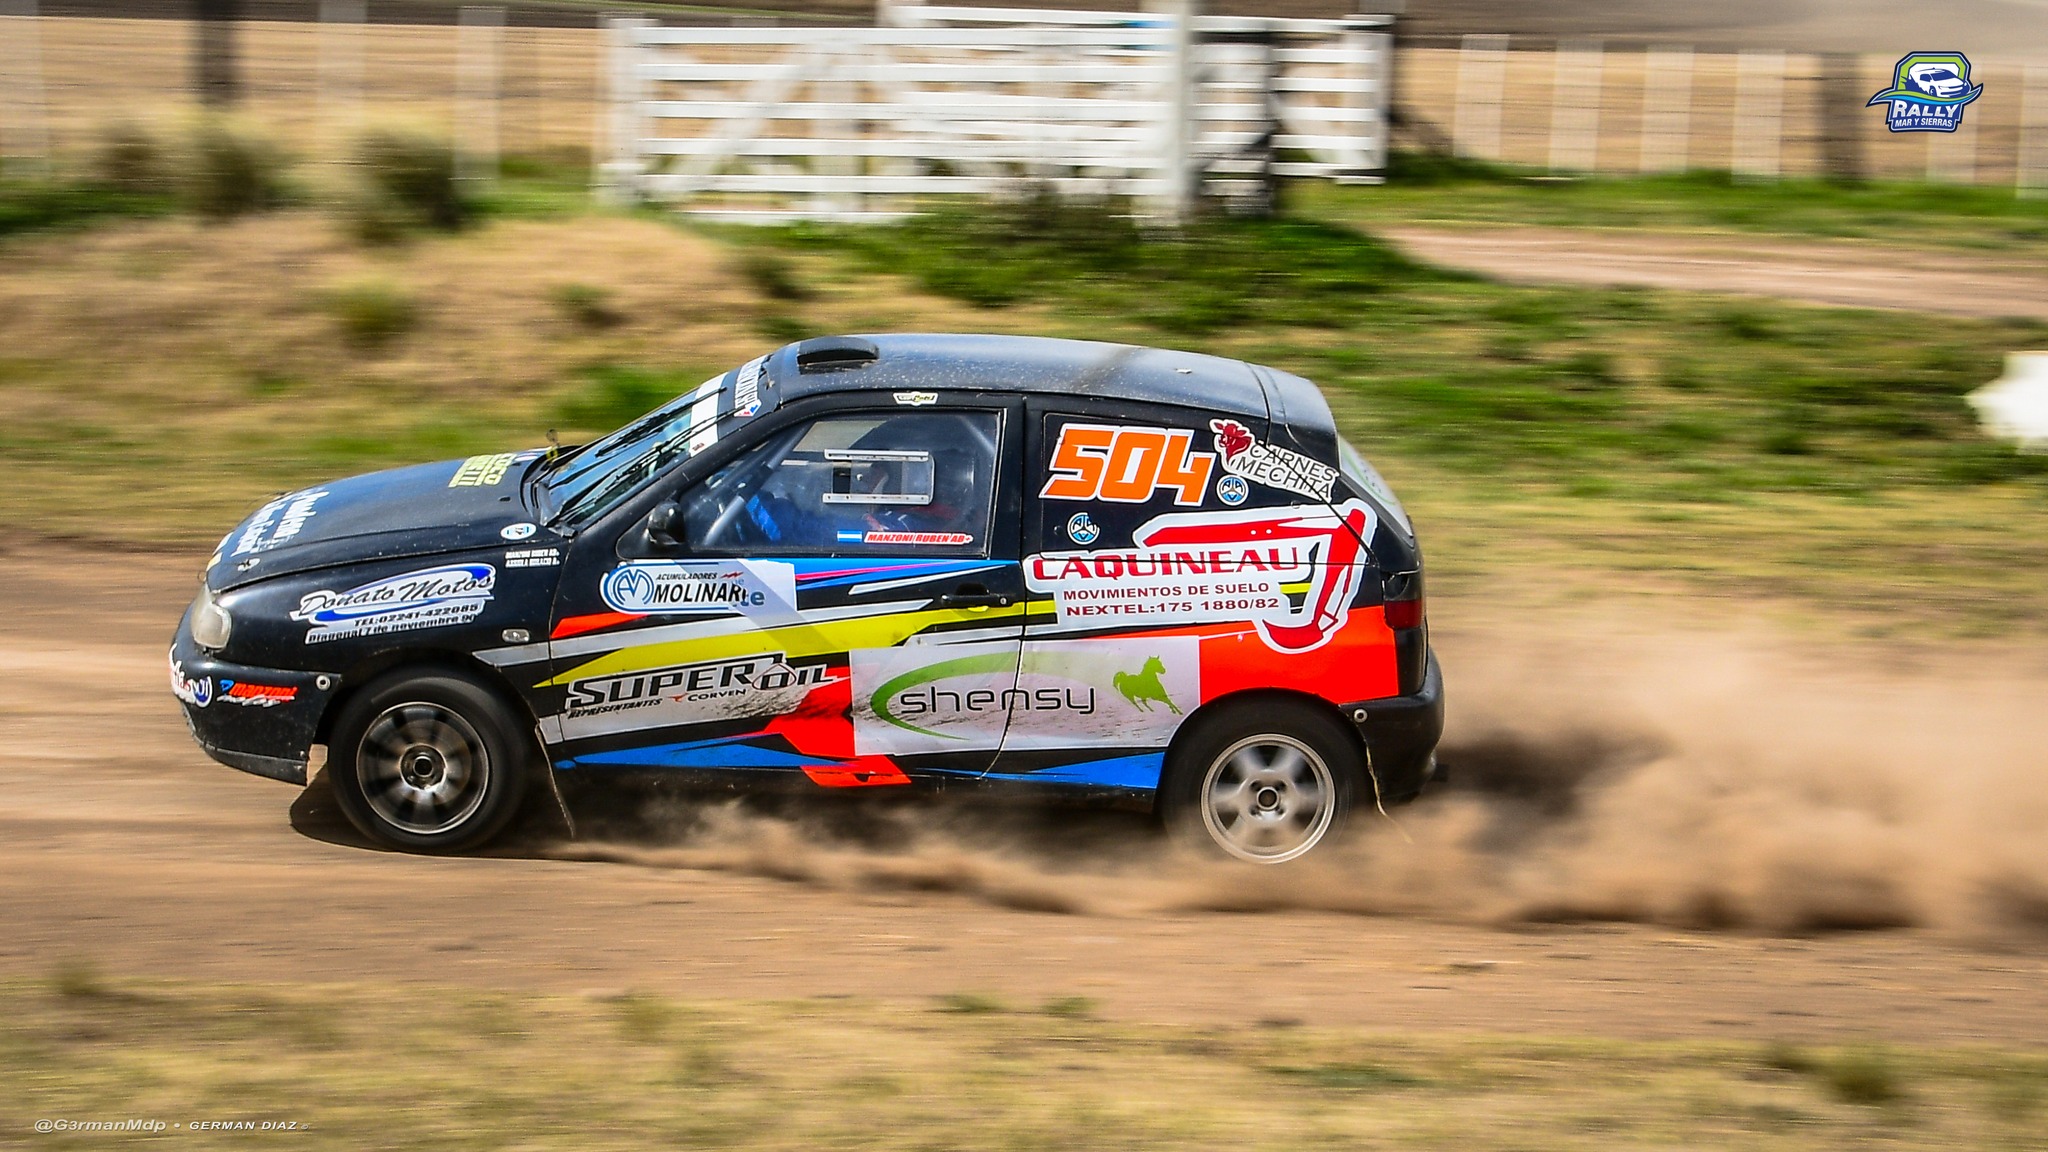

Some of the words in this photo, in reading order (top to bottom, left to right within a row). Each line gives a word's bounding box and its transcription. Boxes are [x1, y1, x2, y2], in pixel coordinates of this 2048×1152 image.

[1042, 426, 1214, 504] 504
[1235, 457, 1331, 499] MECHITA
[1250, 444, 1337, 481] CARNES
[867, 534, 914, 542] MANZONI
[915, 534, 949, 543] RUBEN
[656, 572, 718, 581] ACUMULADORES
[1033, 547, 1298, 580] CAQUINEAU
[299, 586, 395, 616] Donato
[398, 576, 493, 601] Motos
[1064, 586, 1182, 600] MOVIMIENTOS
[1188, 585, 1209, 596] DE
[1215, 582, 1269, 594] SUELO
[1066, 602, 1192, 616] NEXTEL:175
[1201, 598, 1279, 611] 1880/82
[568, 656, 766, 710] SUPER
[759, 664, 834, 691] OIL
[568, 698, 663, 719] REPRESENTANTES
[687, 689, 746, 702] CORVEN
[900, 686, 1096, 715] shensy
